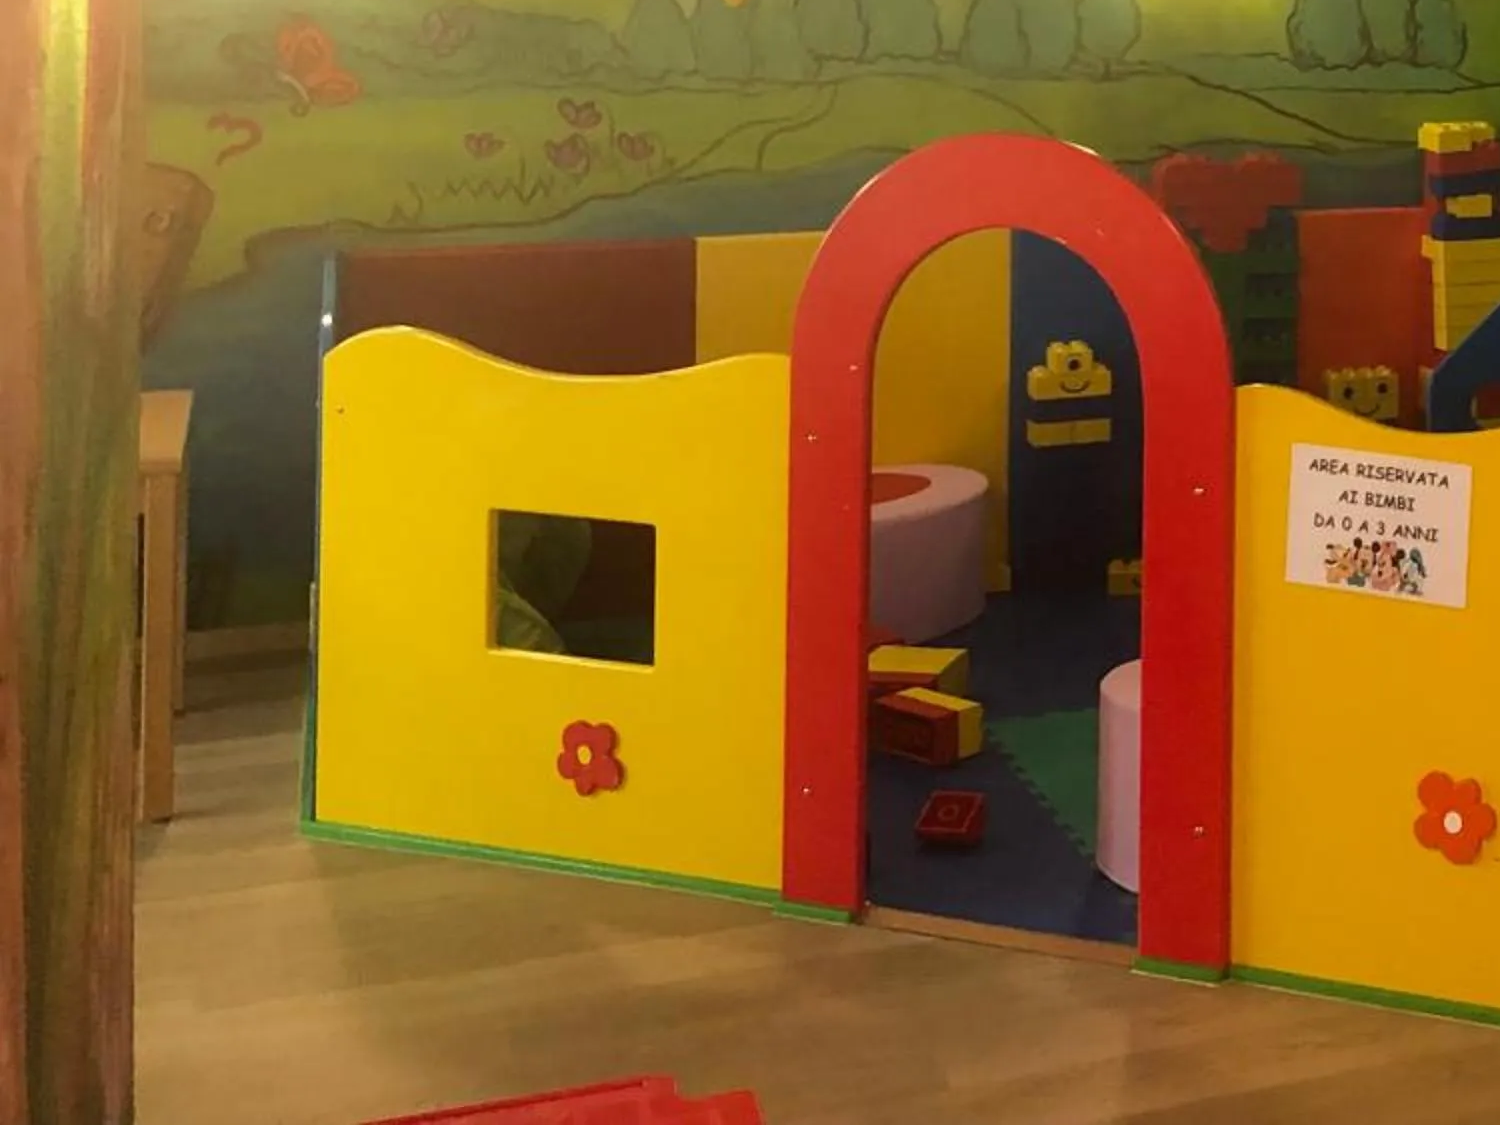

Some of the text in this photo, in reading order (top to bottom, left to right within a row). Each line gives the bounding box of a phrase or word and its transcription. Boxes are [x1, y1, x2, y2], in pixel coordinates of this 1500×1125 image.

[1309, 458, 1450, 489] AREA RISERVATA
[1338, 490, 1416, 512] AI BIMBI
[1313, 512, 1335, 530] DA
[1358, 520, 1369, 534] A
[1376, 521, 1385, 536] 3
[1392, 524, 1439, 543] ANNI
